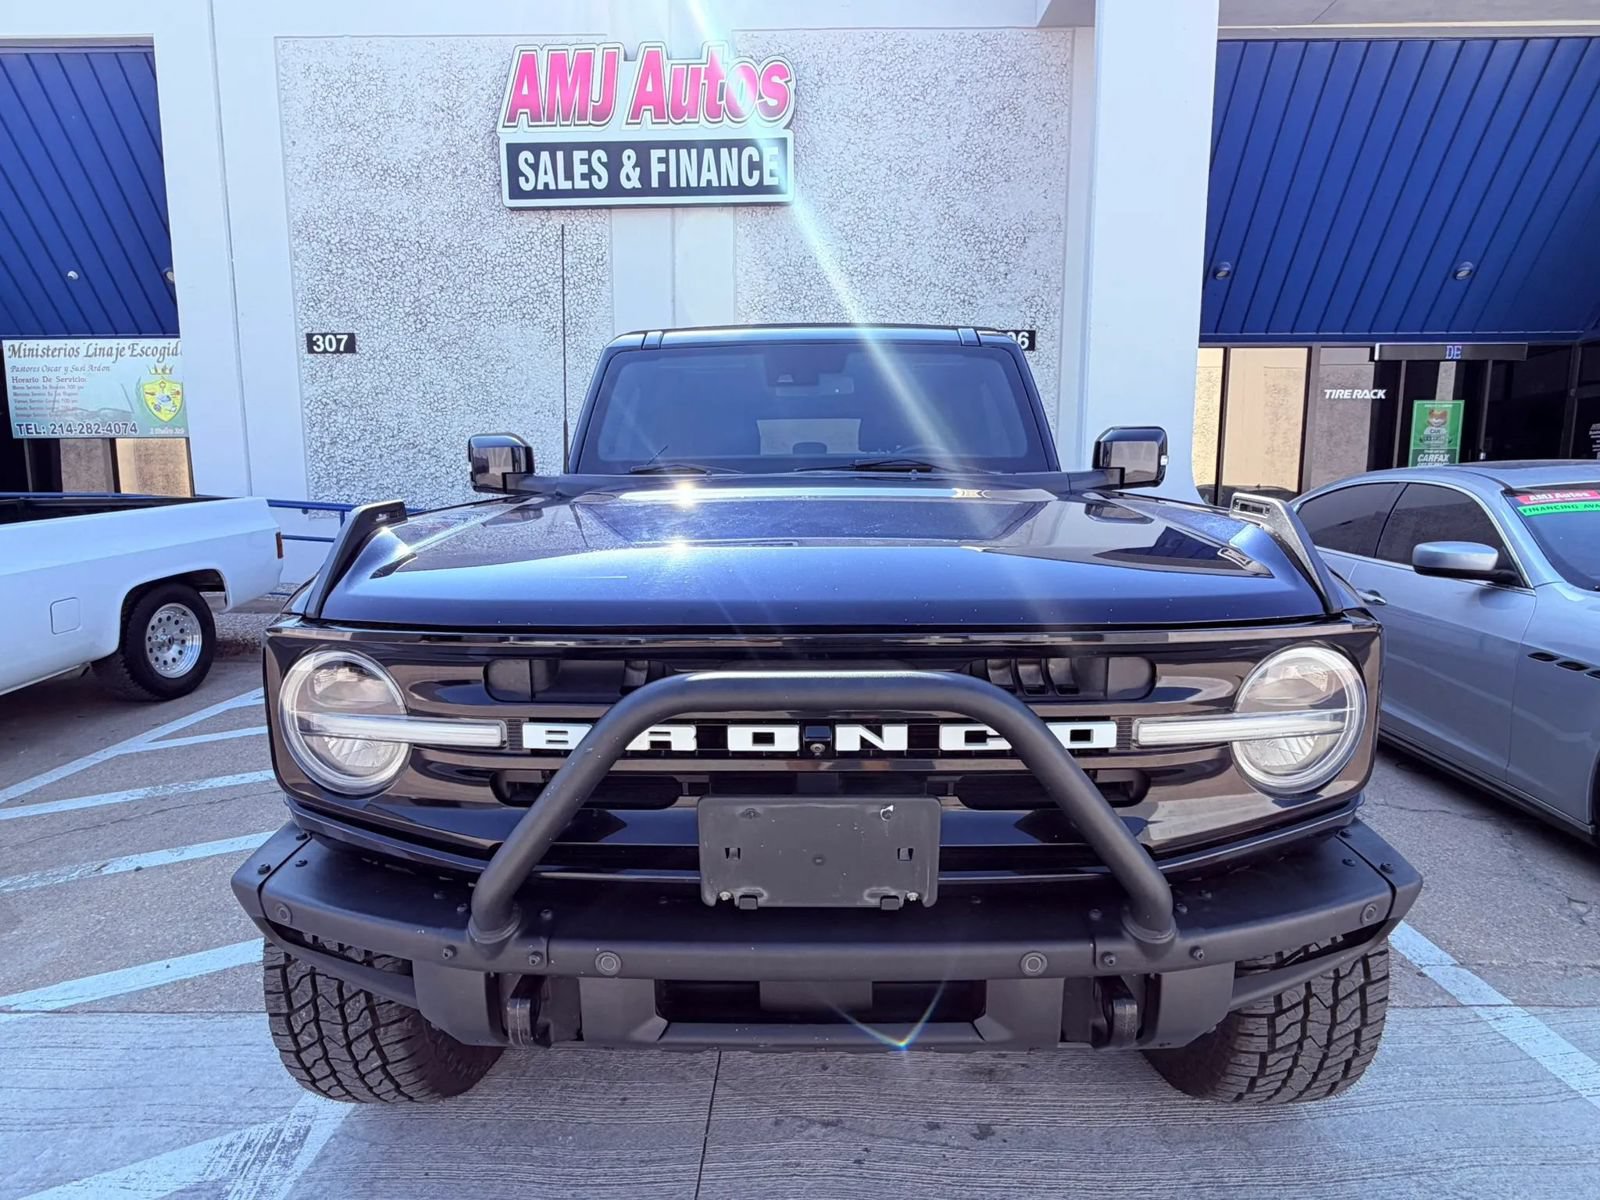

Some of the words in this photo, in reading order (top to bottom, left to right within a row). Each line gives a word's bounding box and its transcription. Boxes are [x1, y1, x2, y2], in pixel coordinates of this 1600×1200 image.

[503, 47, 620, 126] AMJ
[626, 46, 792, 125] Autos
[518, 150, 609, 191] SALES
[619, 148, 642, 190] &
[650, 145, 780, 188] FINANCE
[312, 334, 349, 353] 307
[8, 342, 81, 359] Ministerios
[84, 342, 126, 363] Linaje
[127, 341, 182, 363] Escogid
[1445, 345, 1462, 359] DE
[11, 376, 39, 384] Horario
[16, 422, 46, 435] TEL:
[49, 421, 138, 435] 214-282-4074
[1417, 453, 1450, 462] CARFAX
